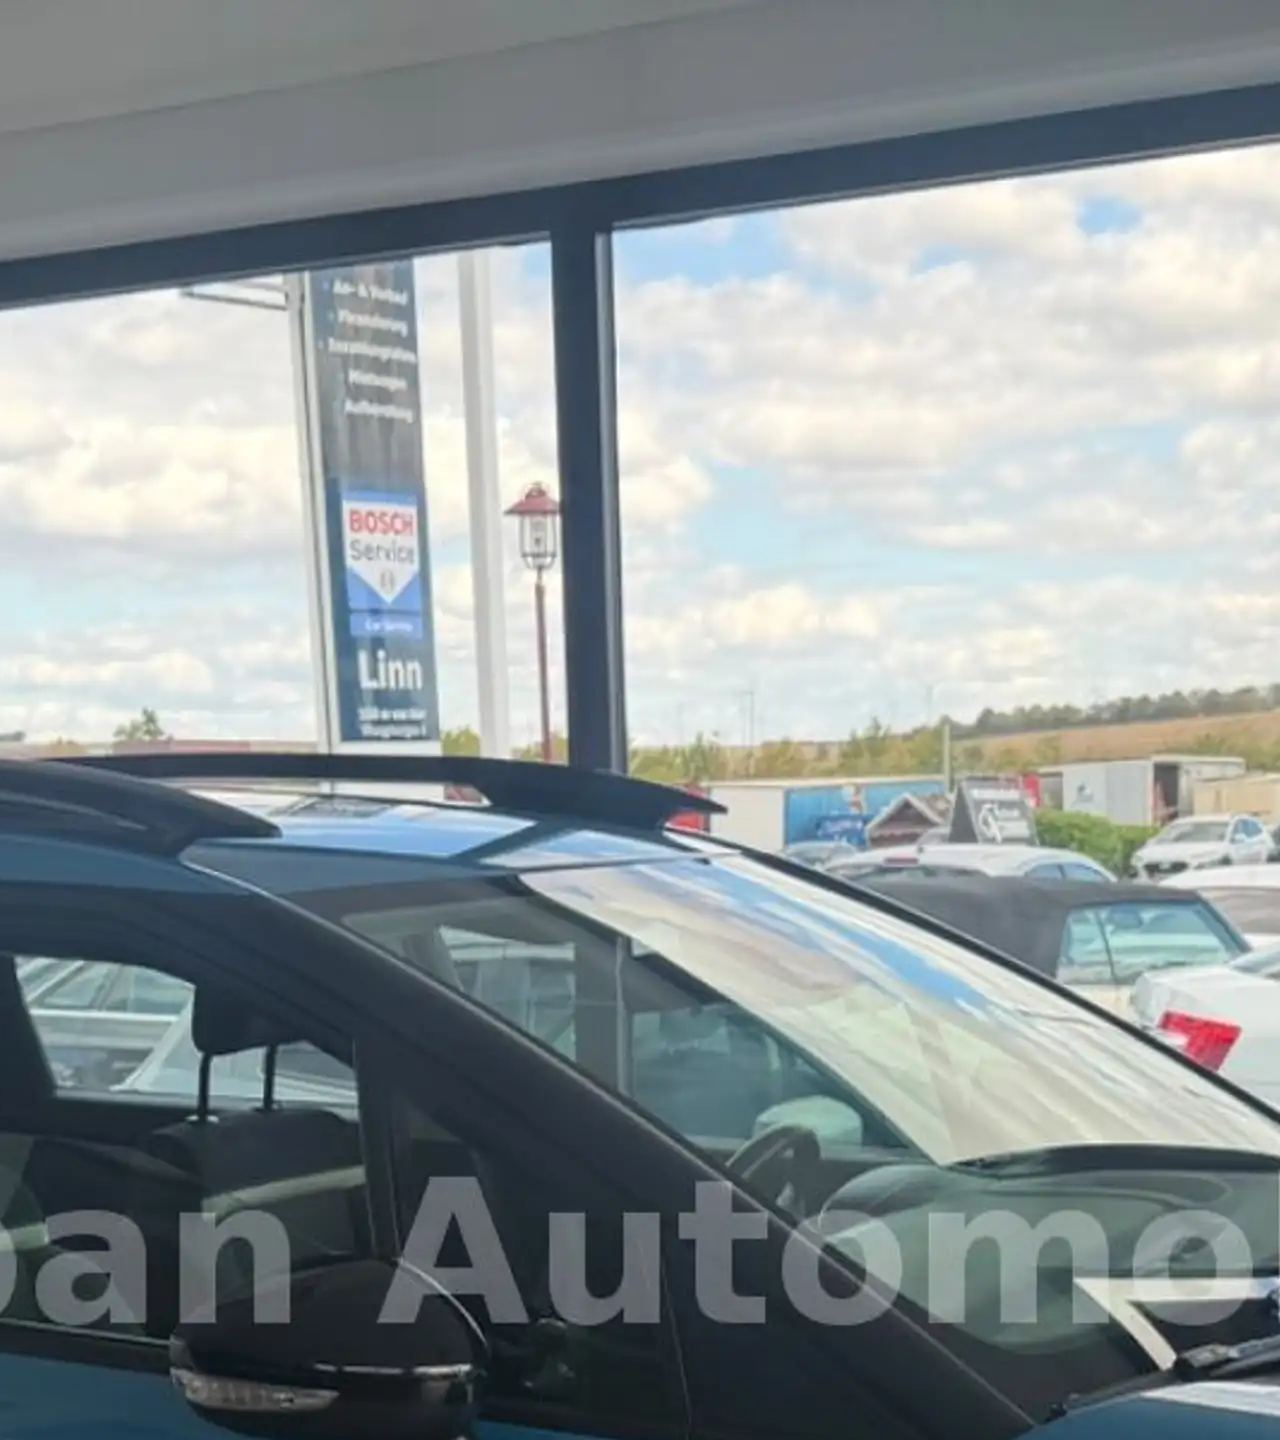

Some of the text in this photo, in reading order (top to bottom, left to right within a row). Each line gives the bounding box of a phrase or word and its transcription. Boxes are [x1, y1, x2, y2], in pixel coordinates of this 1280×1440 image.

[349, 509, 414, 536] BOSCH
[350, 538, 415, 565] Service
[357, 648, 423, 691] Linn
